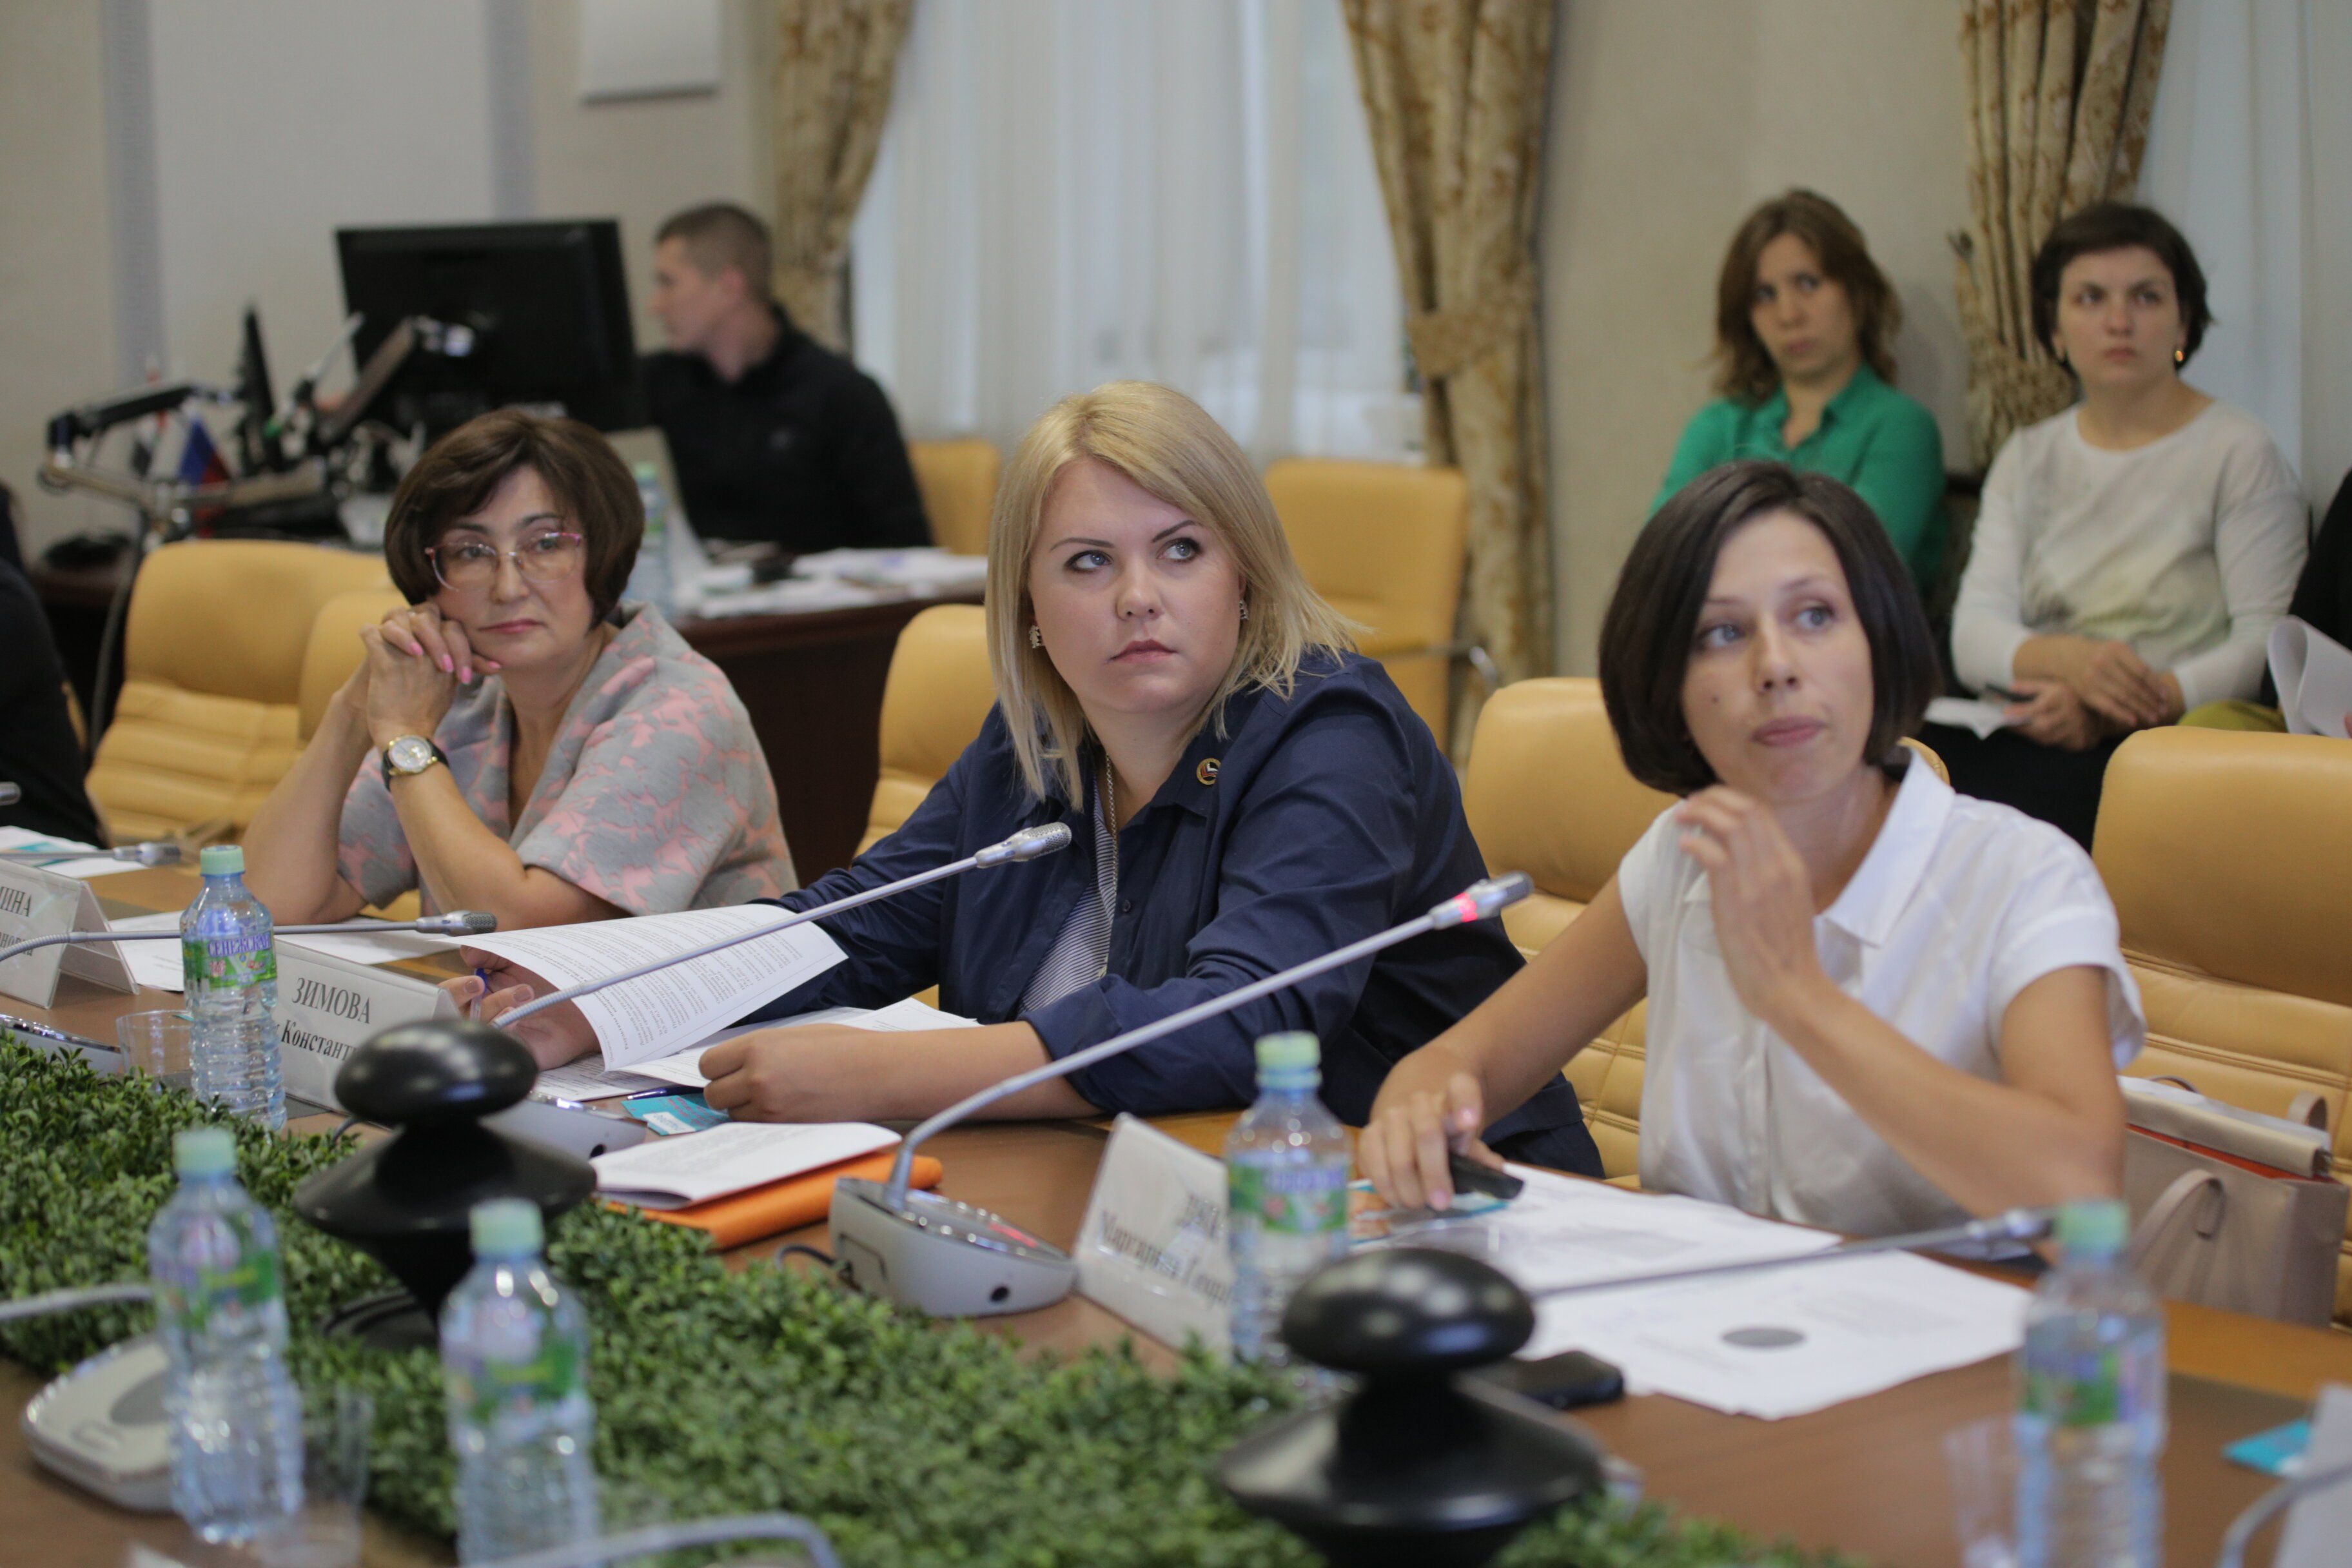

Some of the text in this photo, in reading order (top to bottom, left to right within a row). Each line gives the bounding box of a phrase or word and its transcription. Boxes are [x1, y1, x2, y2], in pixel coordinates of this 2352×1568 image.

[0, 887, 31, 917] ИНА
[292, 977, 370, 1024] ЗИМОВА
[281, 1019, 359, 1062] Констант
